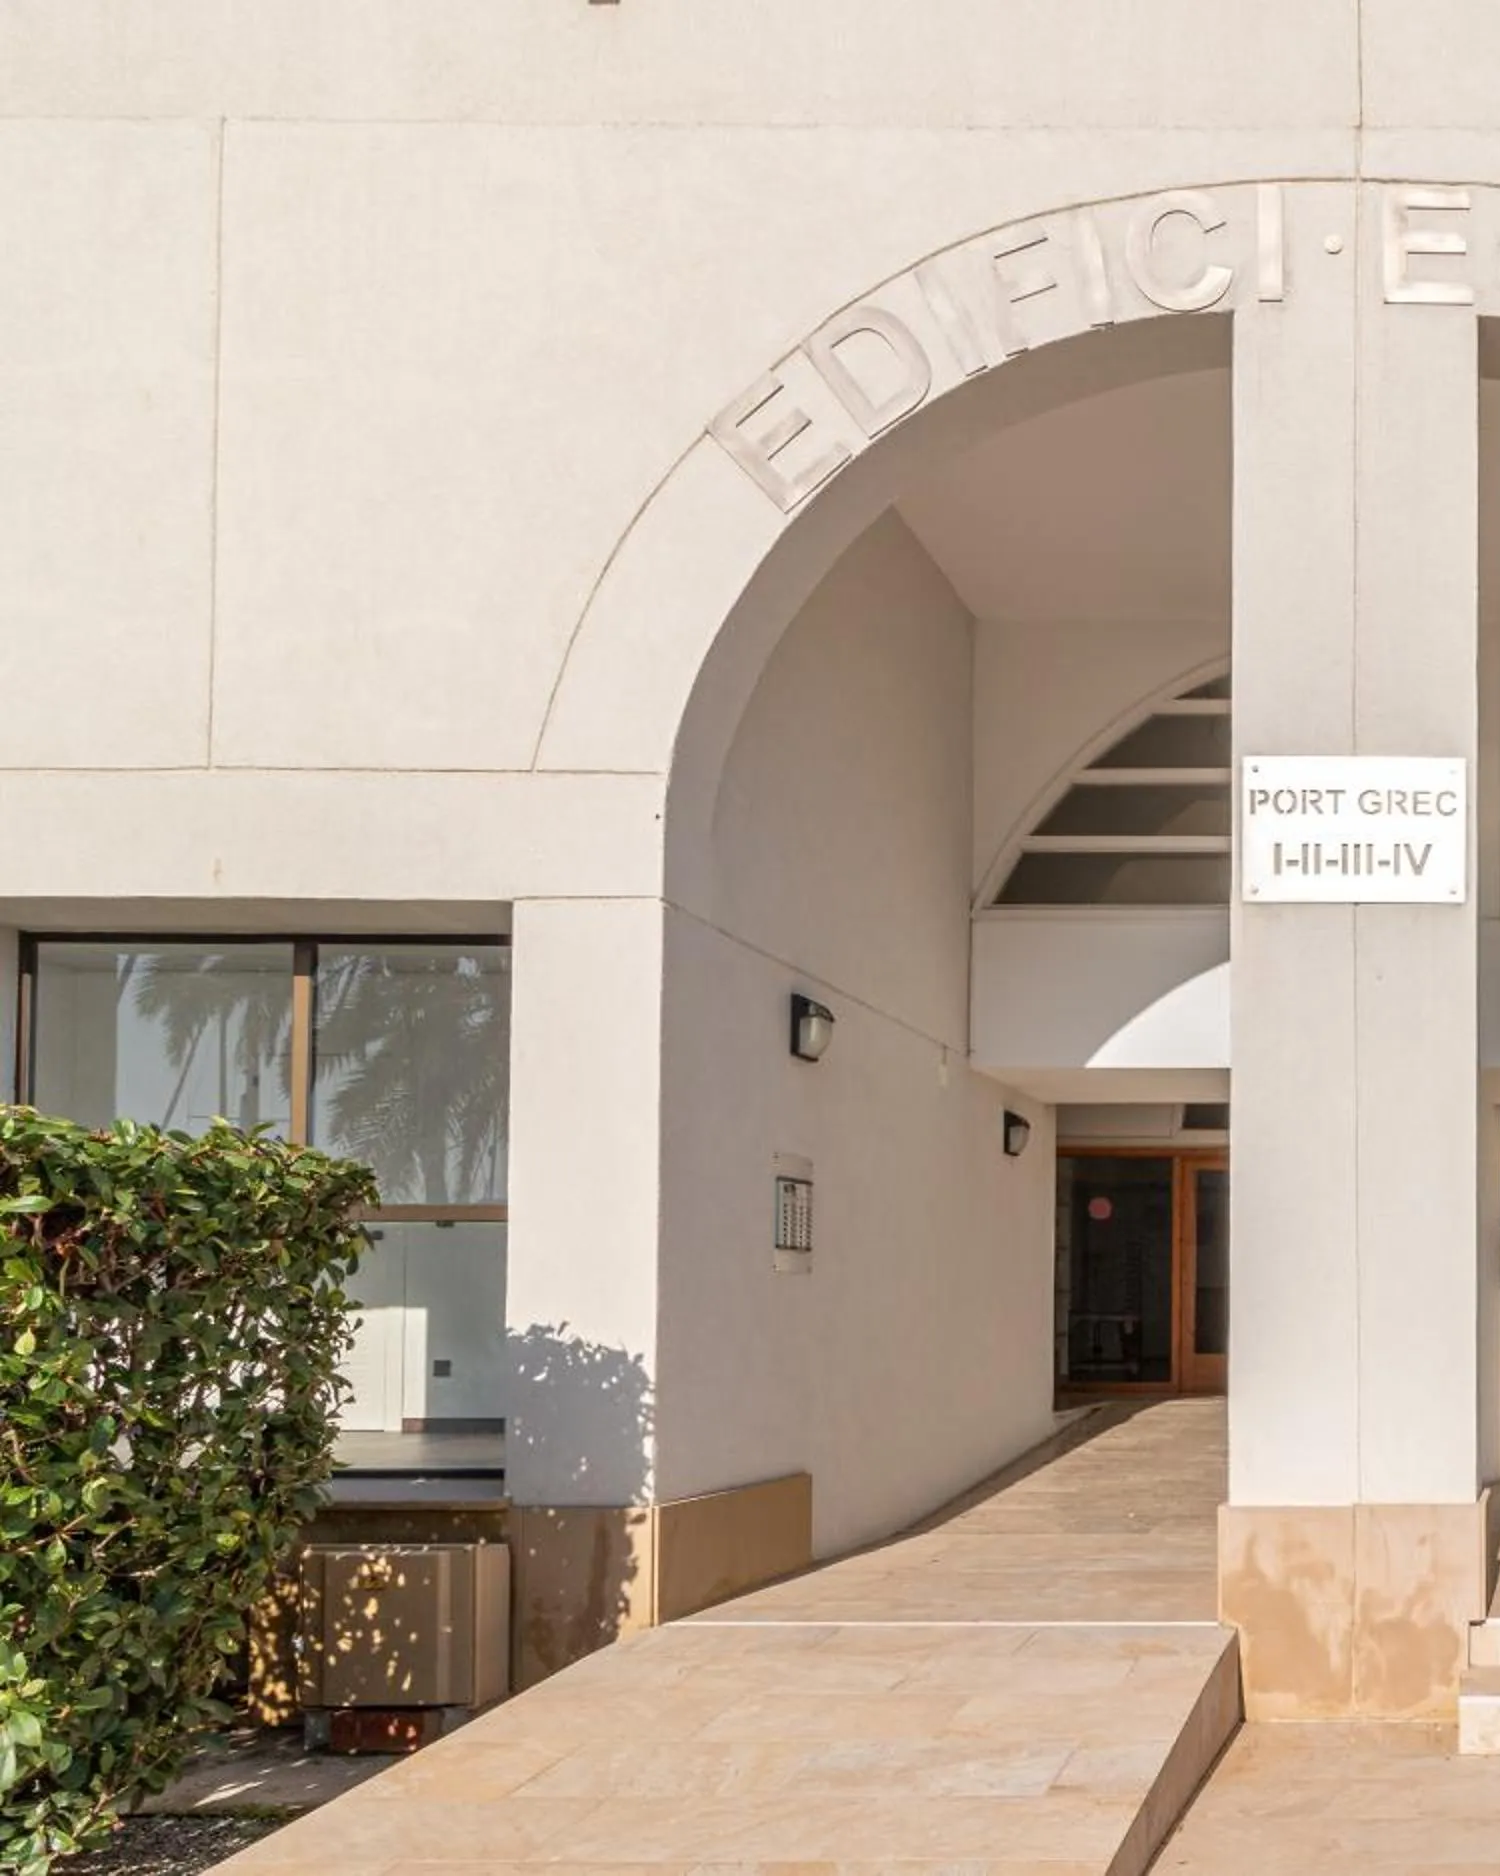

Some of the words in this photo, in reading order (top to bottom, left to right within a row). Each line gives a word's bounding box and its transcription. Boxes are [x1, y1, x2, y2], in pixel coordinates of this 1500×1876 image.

[706, 182, 1286, 515] EDIFICI
[1249, 789, 1347, 815] PORT
[1358, 789, 1458, 817] GREC
[1273, 843, 1433, 876] I-II-III-IV
